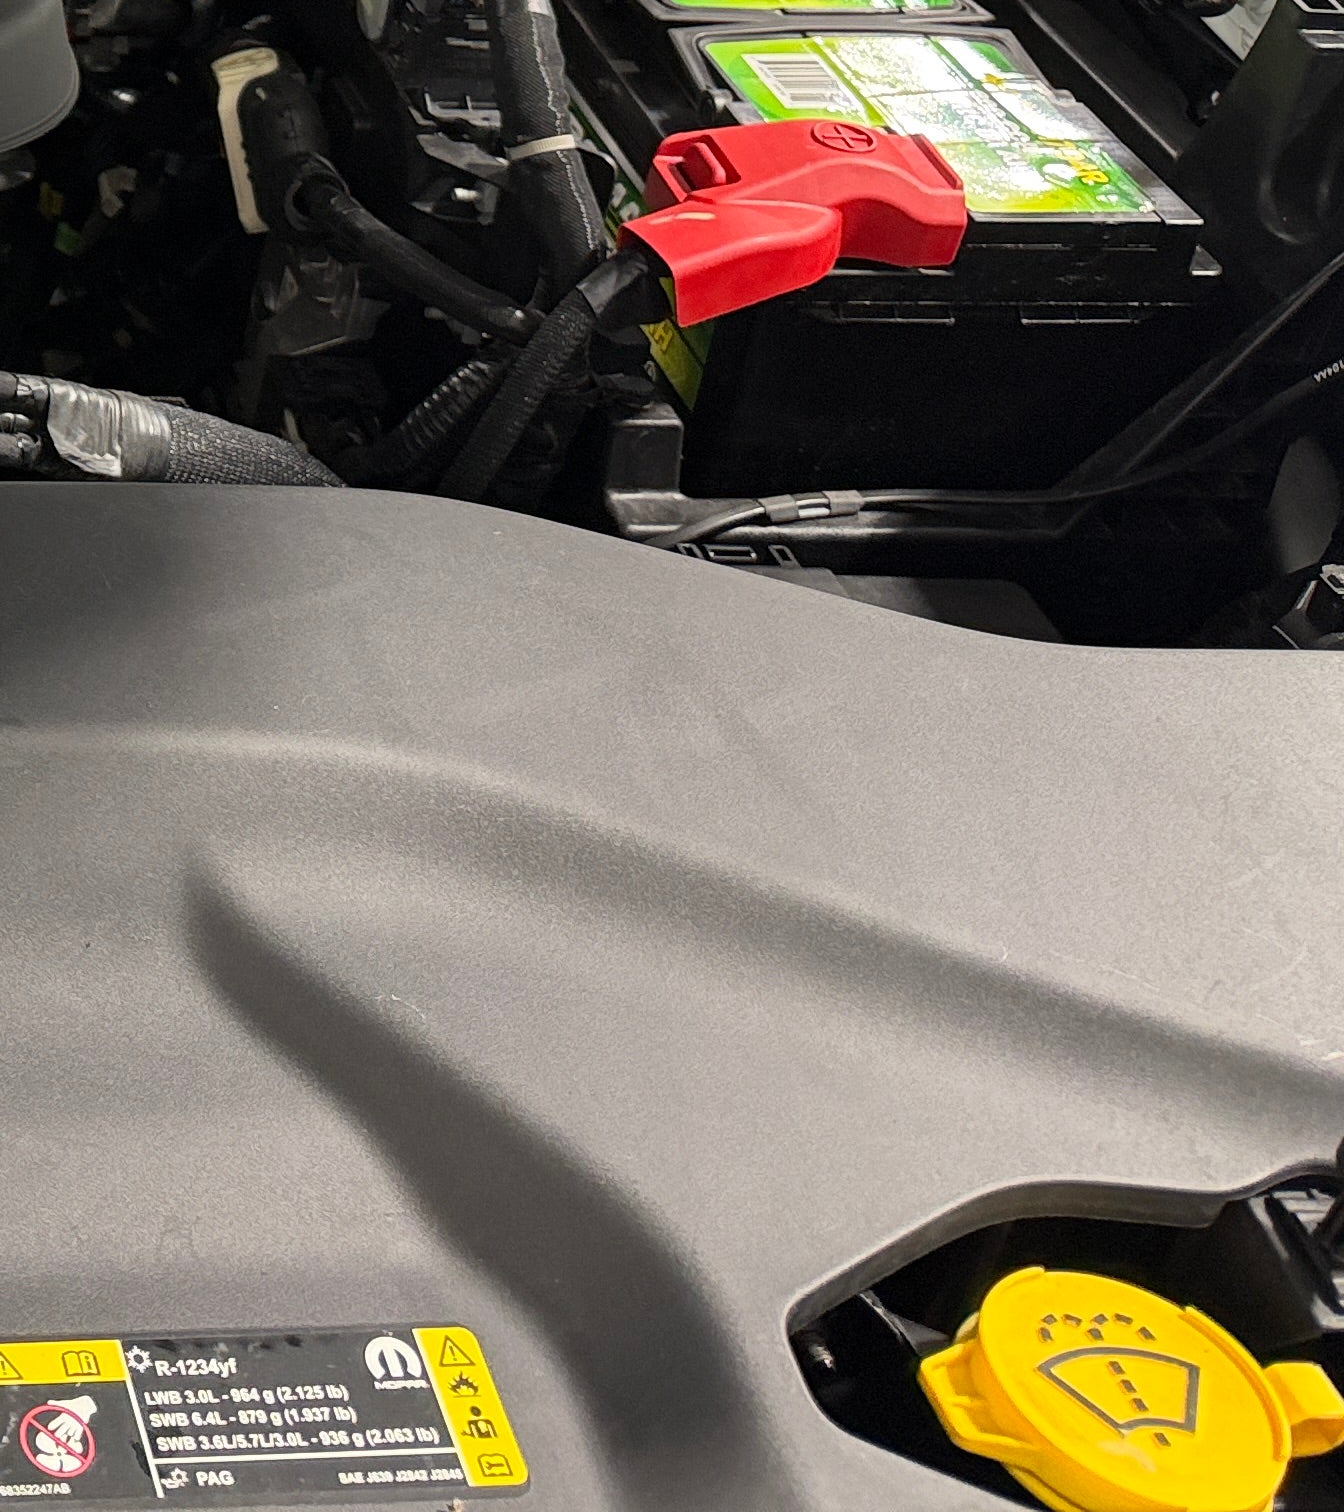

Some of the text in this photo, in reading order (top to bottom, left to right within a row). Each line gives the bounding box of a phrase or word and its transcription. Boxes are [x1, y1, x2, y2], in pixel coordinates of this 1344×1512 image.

[155, 1357, 238, 1380] R-1234yf
[144, 1389, 183, 1406] LWB
[185, 1388, 220, 1404] 3.0L
[231, 1387, 261, 1403] 964
[263, 1389, 275, 1405] g
[276, 1385, 325, 1405] (2.125
[326, 1383, 350, 1402] lb)
[149, 1412, 189, 1428] SWB
[191, 1411, 227, 1427] 6.4L
[239, 1409, 268, 1425] 879
[271, 1412, 283, 1428] g
[284, 1407, 331, 1426] (1.937
[333, 1406, 358, 1424] lb)
[156, 1436, 196, 1452] SWB
[200, 1431, 309, 1451] 3.6L/5.7L/3.0L
[319, 1430, 349, 1446] 936
[353, 1433, 365, 1449] g
[365, 1428, 414, 1447] (2.063
[415, 1426, 440, 1445] lb)
[196, 1470, 235, 1486] PAG
